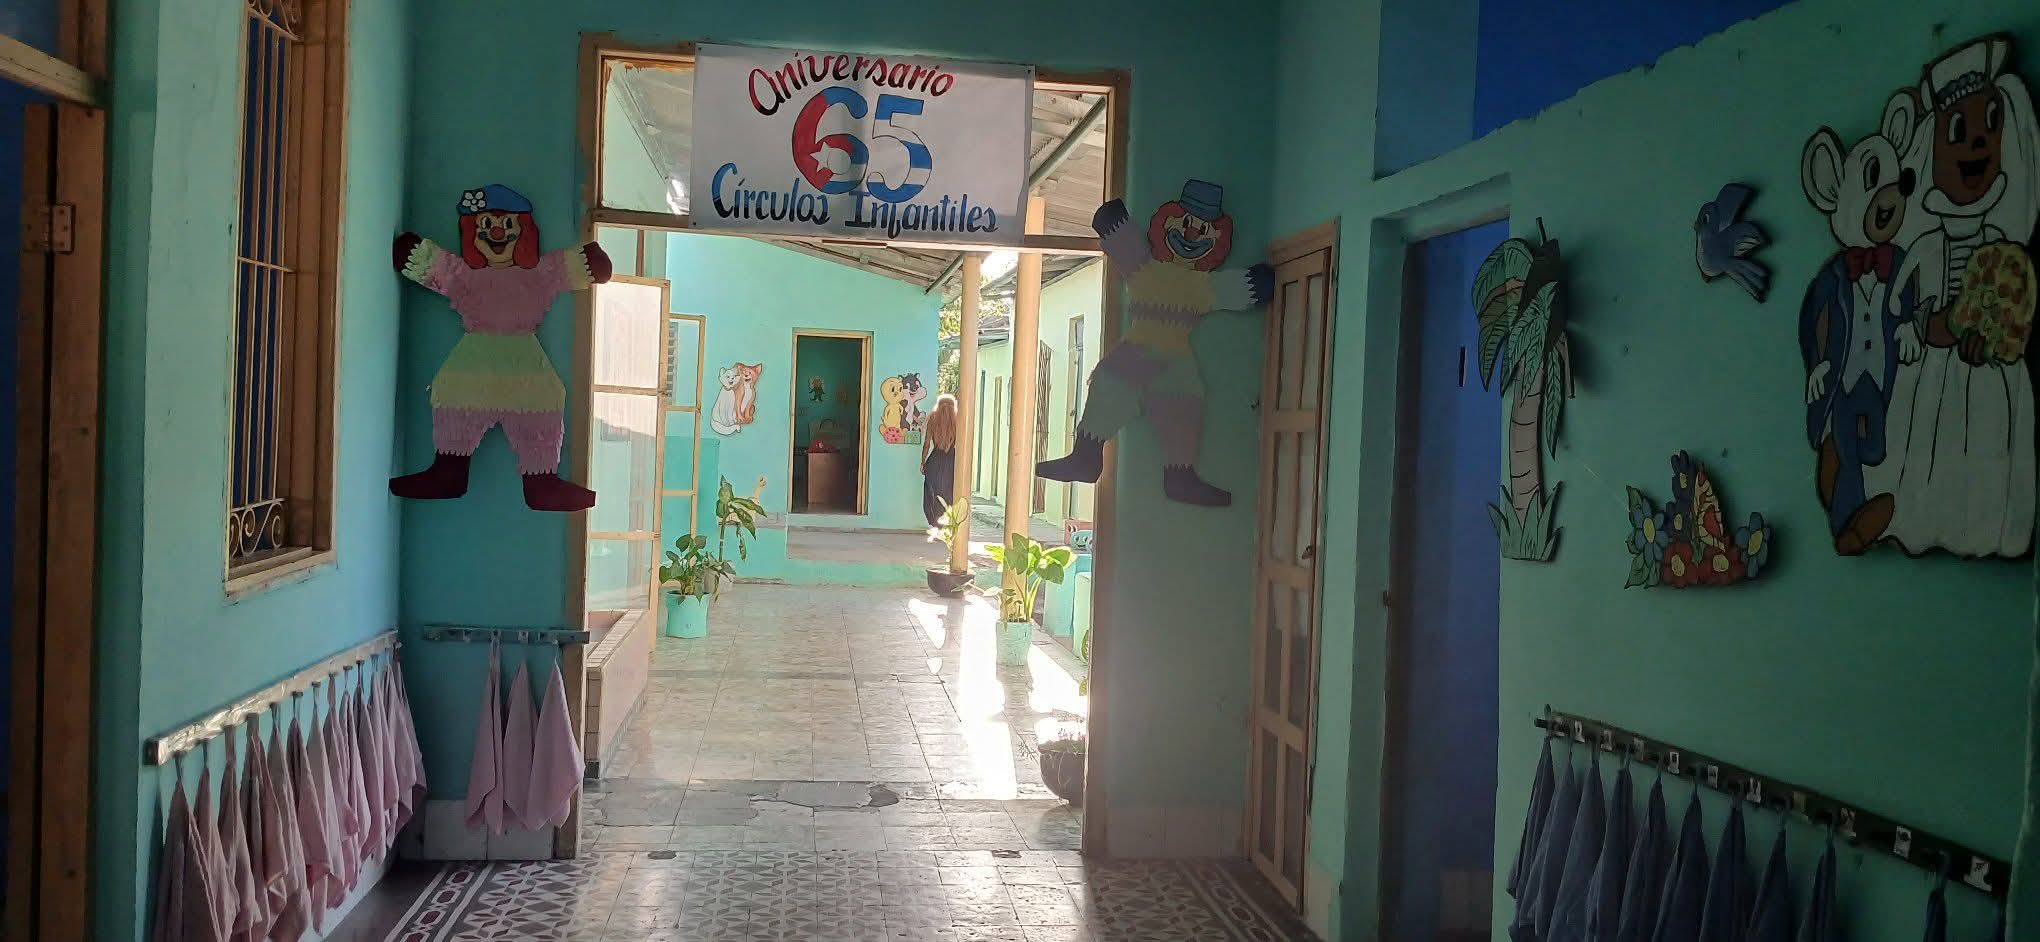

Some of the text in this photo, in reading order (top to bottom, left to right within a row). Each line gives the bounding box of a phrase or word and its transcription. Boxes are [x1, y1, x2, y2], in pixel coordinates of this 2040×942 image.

[791, 86, 933, 203] 65
[711, 162, 998, 239] Círculos Infantiles
